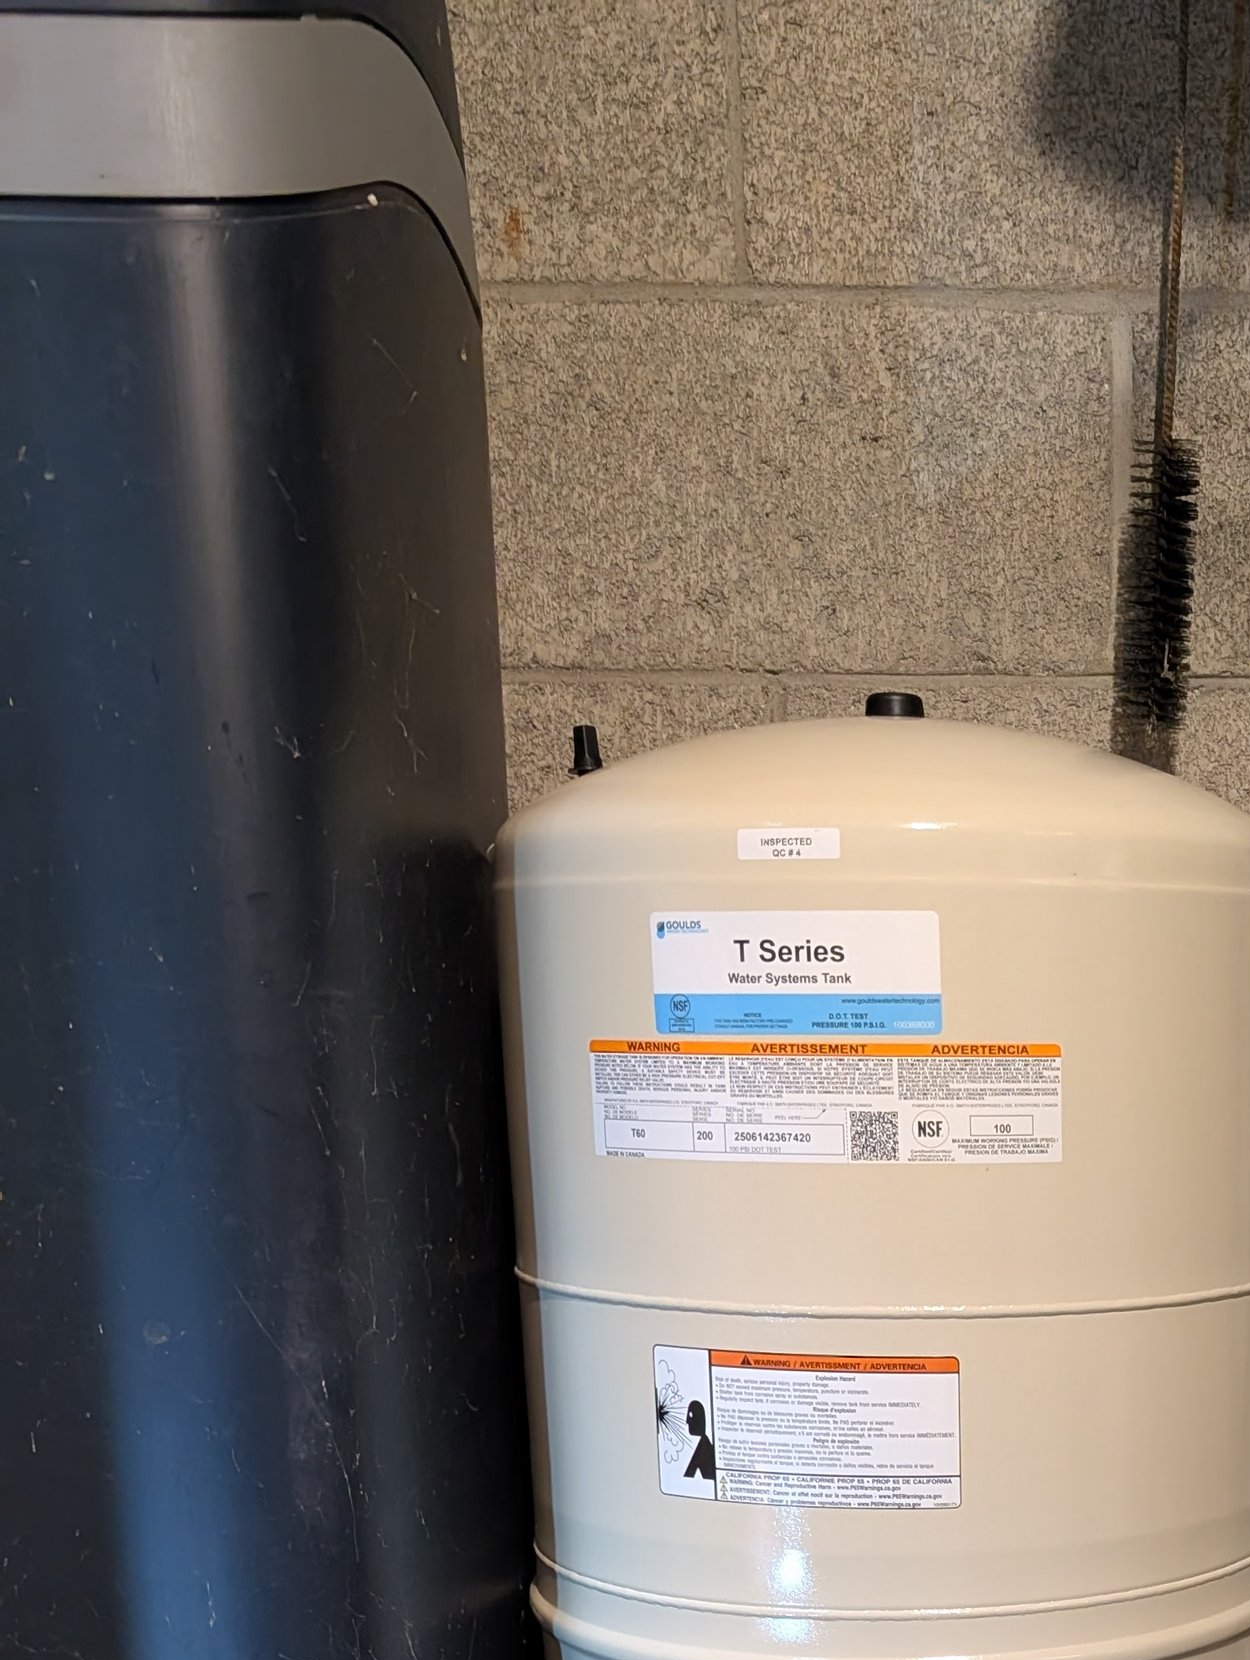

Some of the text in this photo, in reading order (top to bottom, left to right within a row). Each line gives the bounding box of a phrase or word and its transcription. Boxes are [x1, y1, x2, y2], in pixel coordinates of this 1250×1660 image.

[760, 838, 812, 847] INSPECTED
[772, 849, 801, 857] QC # 4
[666, 920, 701, 930] GOULDS
[733, 939, 845, 963] T Series
[728, 972, 852, 986] Water Systems Tank
[673, 1000, 688, 1012] NSF
[627, 1041, 681, 1052] WARNING
[751, 1043, 868, 1054] AVERTISSEMENT
[931, 1045, 1029, 1055] ADVERTENCIA
[631, 1128, 646, 1138] T60
[918, 1121, 943, 1138] NSF
[994, 1124, 1011, 1133] 100
[697, 1131, 713, 1140] 200
[735, 1132, 811, 1142] 2506142367420
[753, 1359, 791, 1367] WARNING
[799, 1361, 861, 1370] AVERTISSMENT
[726, 1472, 761, 1480] CALIFORNIA
